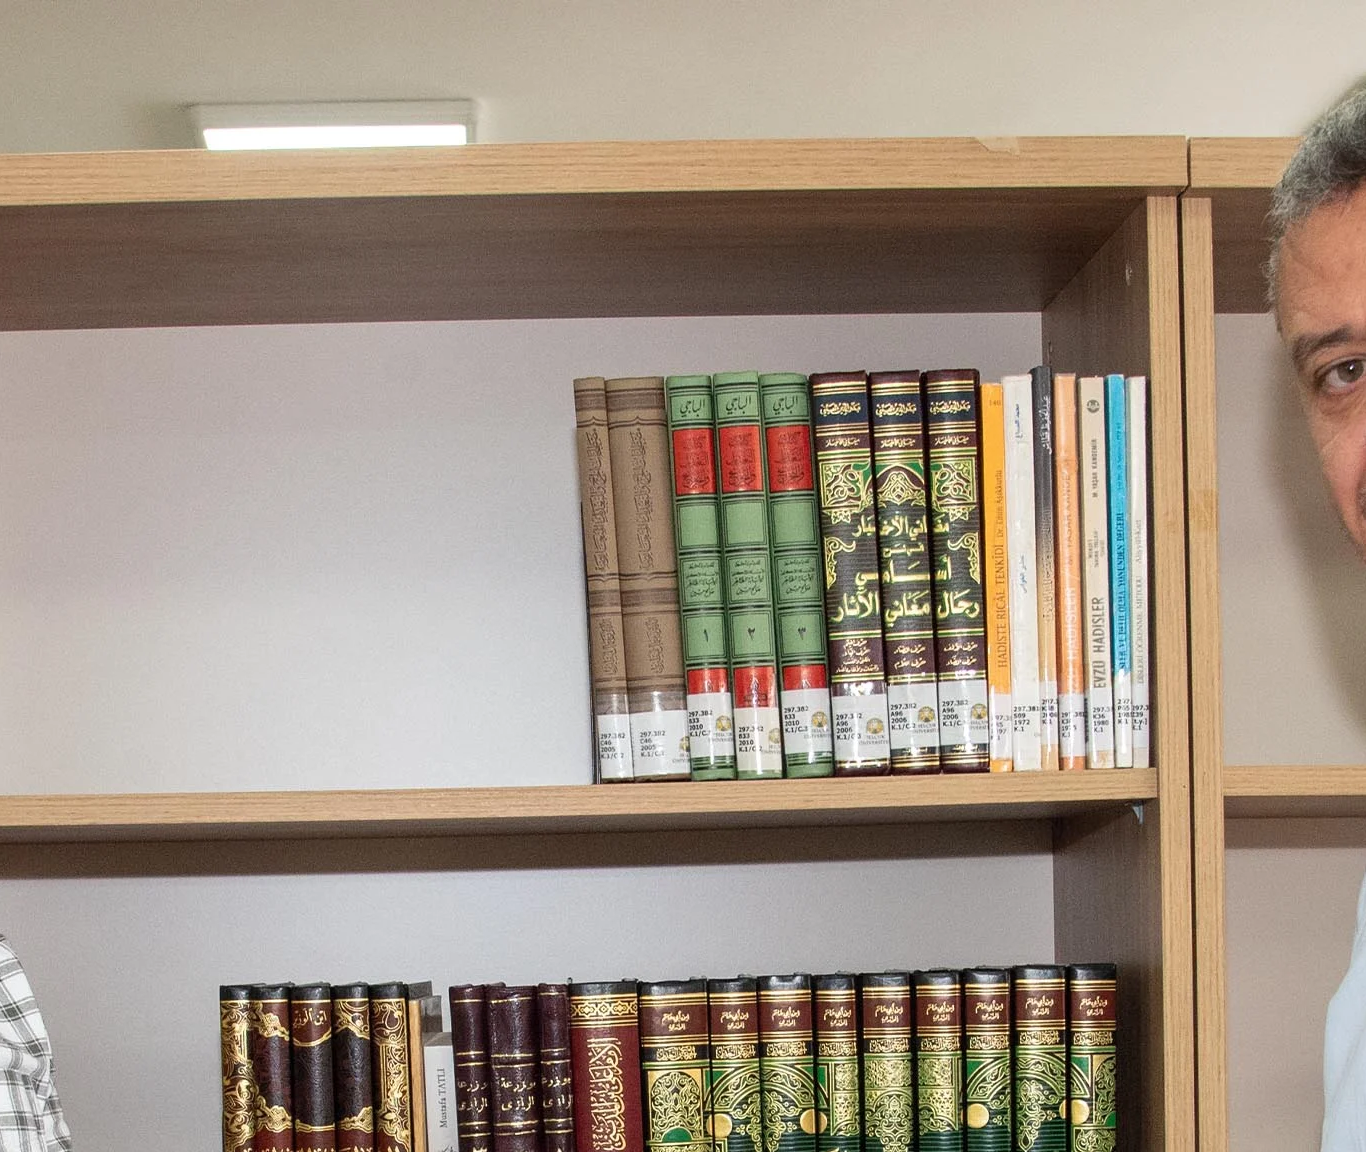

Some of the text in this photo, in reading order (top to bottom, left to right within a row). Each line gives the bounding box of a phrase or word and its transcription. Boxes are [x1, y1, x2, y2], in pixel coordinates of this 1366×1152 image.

[997, 624, 1007, 668] HADİSTE
[438, 1068, 450, 1128] Mustafa TATLI
